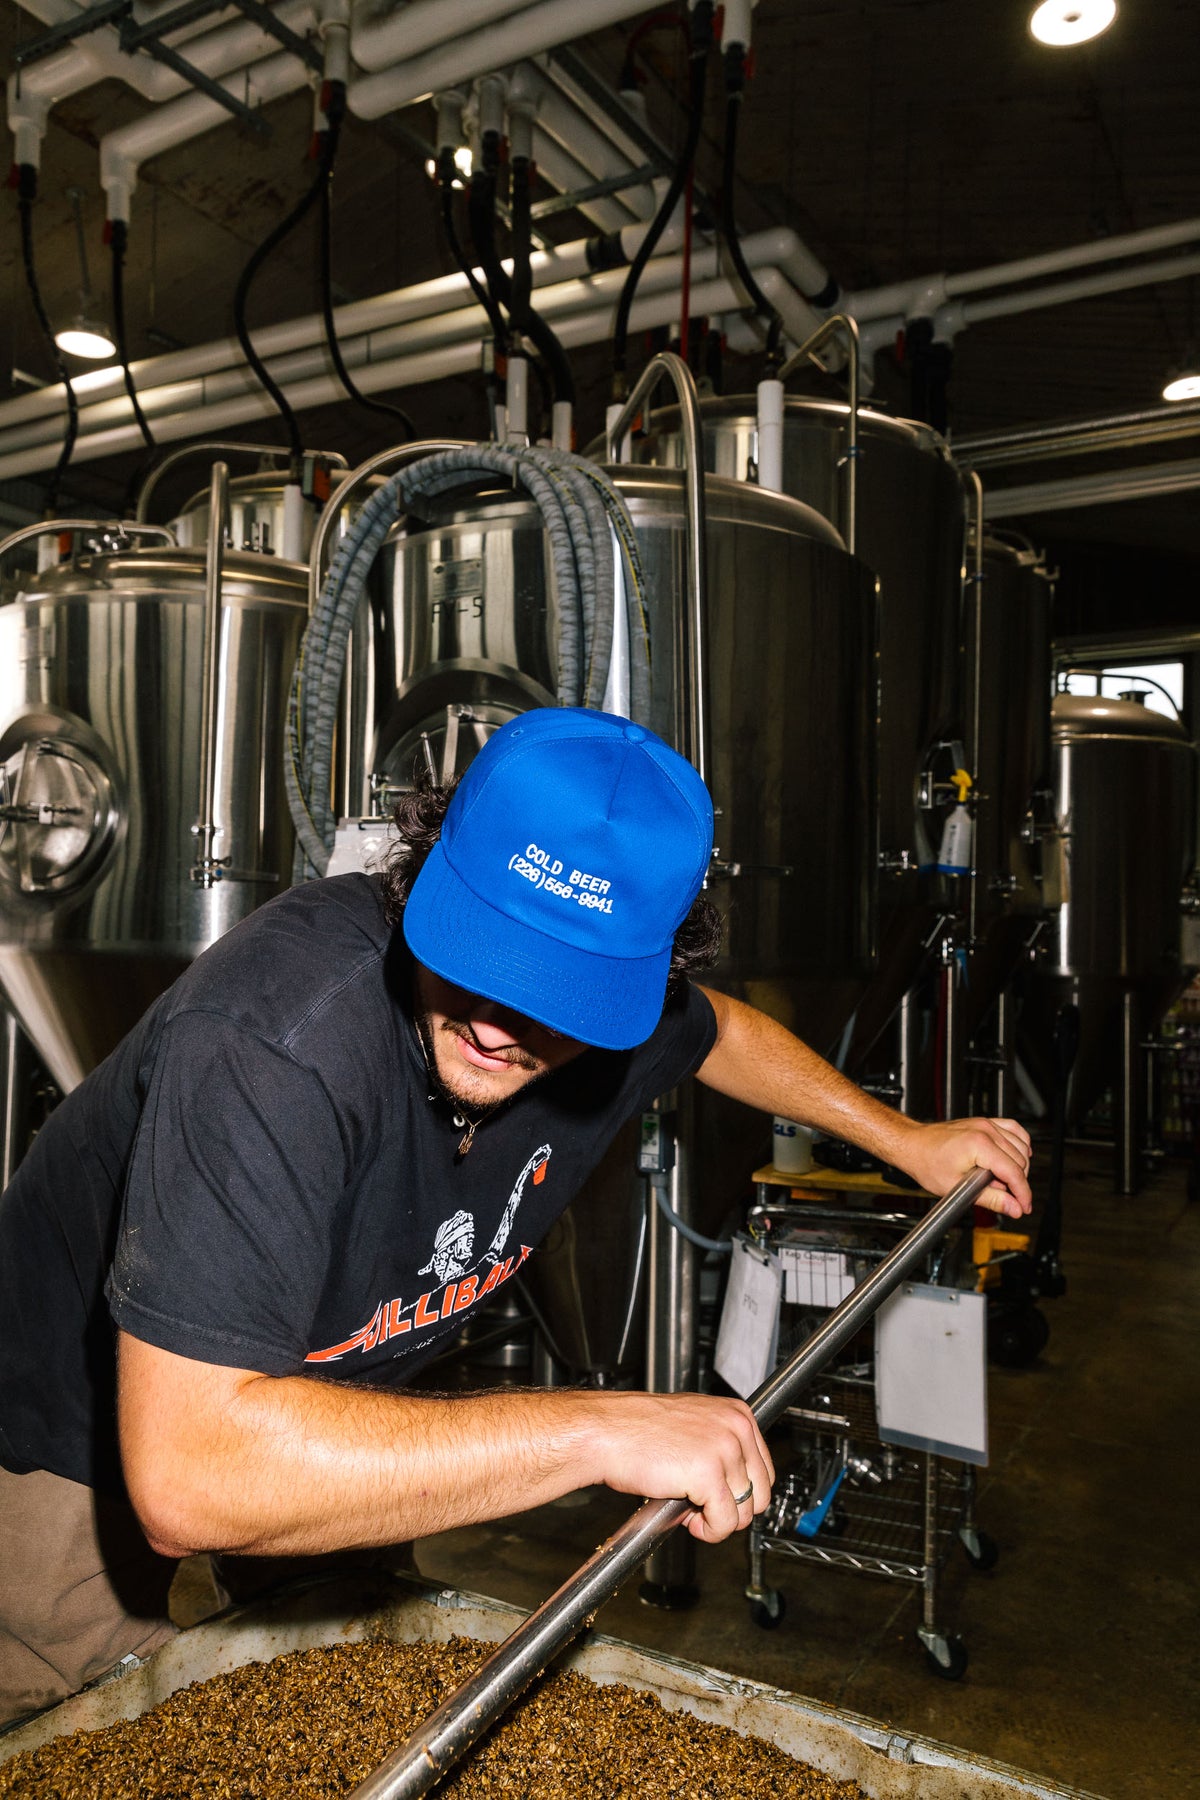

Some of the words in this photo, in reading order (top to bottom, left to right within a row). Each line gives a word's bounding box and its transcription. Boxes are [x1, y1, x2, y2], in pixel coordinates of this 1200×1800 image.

[507, 853, 614, 914] (226)556-9941
[525, 843, 563, 875] COLD
[568, 869, 611, 895] BEER
